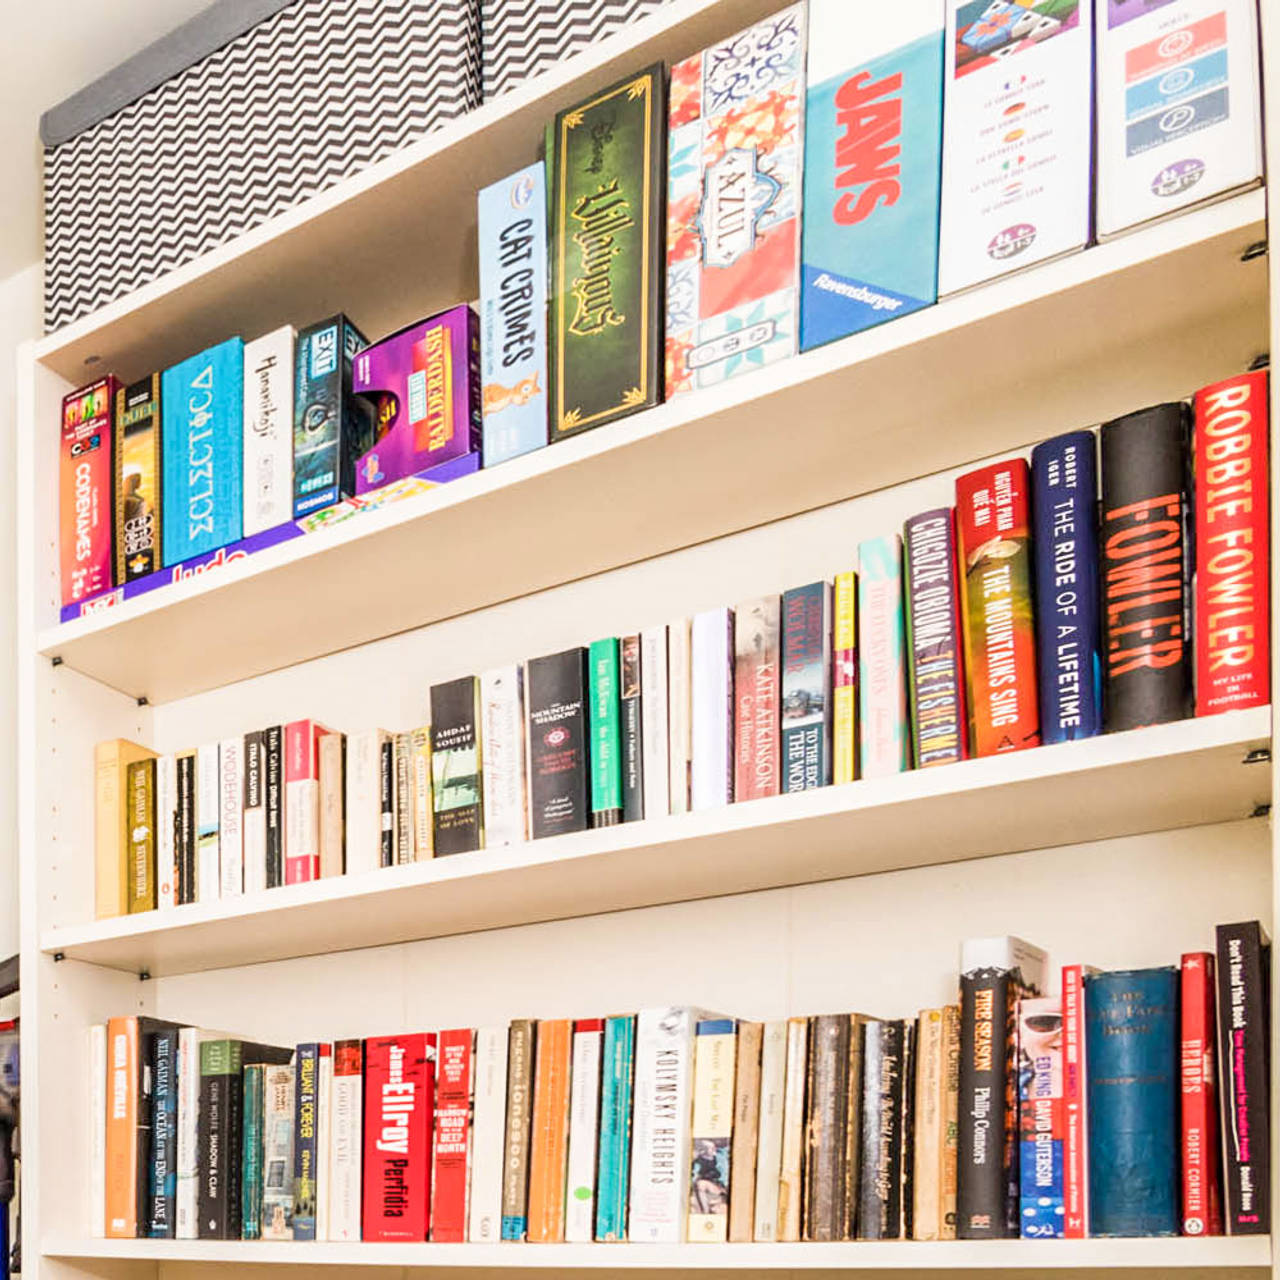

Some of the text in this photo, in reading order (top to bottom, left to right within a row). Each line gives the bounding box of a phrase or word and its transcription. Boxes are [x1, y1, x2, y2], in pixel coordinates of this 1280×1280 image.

[831, 70, 904, 227] JAWS
[717, 166, 745, 250] AZUL
[569, 179, 635, 335] Villainous
[498, 218, 537, 369] CAT CRIMES
[812, 272, 904, 312] Ravensburger
[313, 332, 334, 374] EXIT
[425, 324, 446, 452] BALDERDASH
[1048, 460, 1059, 487] IGER
[1063, 445, 1077, 489] ROBERT
[75, 462, 92, 562] CODENAMES
[1204, 384, 1255, 673] ROBBIE FOWLER
[1105, 494, 1183, 679] FOWLER
[1053, 499, 1081, 729] THE RIDE OF A LIFETIME
[911, 517, 959, 766] CHIGOZIE OBIOMA THE FISHERME
[982, 564, 1019, 729] THE MOUNTAINS SING
[530, 701, 581, 719] MOUNTAIN
[534, 710, 579, 725] SHADOW
[754, 662, 775, 791] KATE ATKINSON
[436, 723, 472, 740] AHDAF
[249, 743, 258, 807] ITALO CALVINO
[788, 731, 805, 794] THE WOR
[807, 728, 819, 790] TO THE EDG
[223, 745, 239, 840] WODEHOUSE
[1229, 939, 1244, 963] Don't
[1230, 963, 1244, 986] Read
[1231, 987, 1244, 1006] This
[1232, 1006, 1246, 1029] Book
[156, 1039, 168, 1059] NEIL
[156, 1059, 168, 1097] GAIMAN
[209, 1082, 219, 1103] GENE
[301, 1059, 314, 1095] BRILLIANT
[970, 989, 993, 1165] FIRE SEASON Philip Connors
[1035, 1056, 1052, 1097] ED KING
[156, 1111, 168, 1141] OCEAN
[209, 1104, 219, 1131] WOLFE
[301, 1102, 314, 1138] FOREVER
[376, 1045, 416, 1218] James Ellroy Perfidia
[650, 1049, 680, 1184] KOLYMSKY HEIGHTS
[1182, 1039, 1202, 1213] HEROES ROBERT CORMIER
[209, 1133, 220, 1168] SHADOW
[302, 1150, 311, 1168] KEVIN
[1035, 1100, 1053, 1187] DAVID GUTERSON
[209, 1175, 219, 1199] CLAW
[1241, 1166, 1253, 1193] Donald
[154, 1196, 167, 1221] LANE
